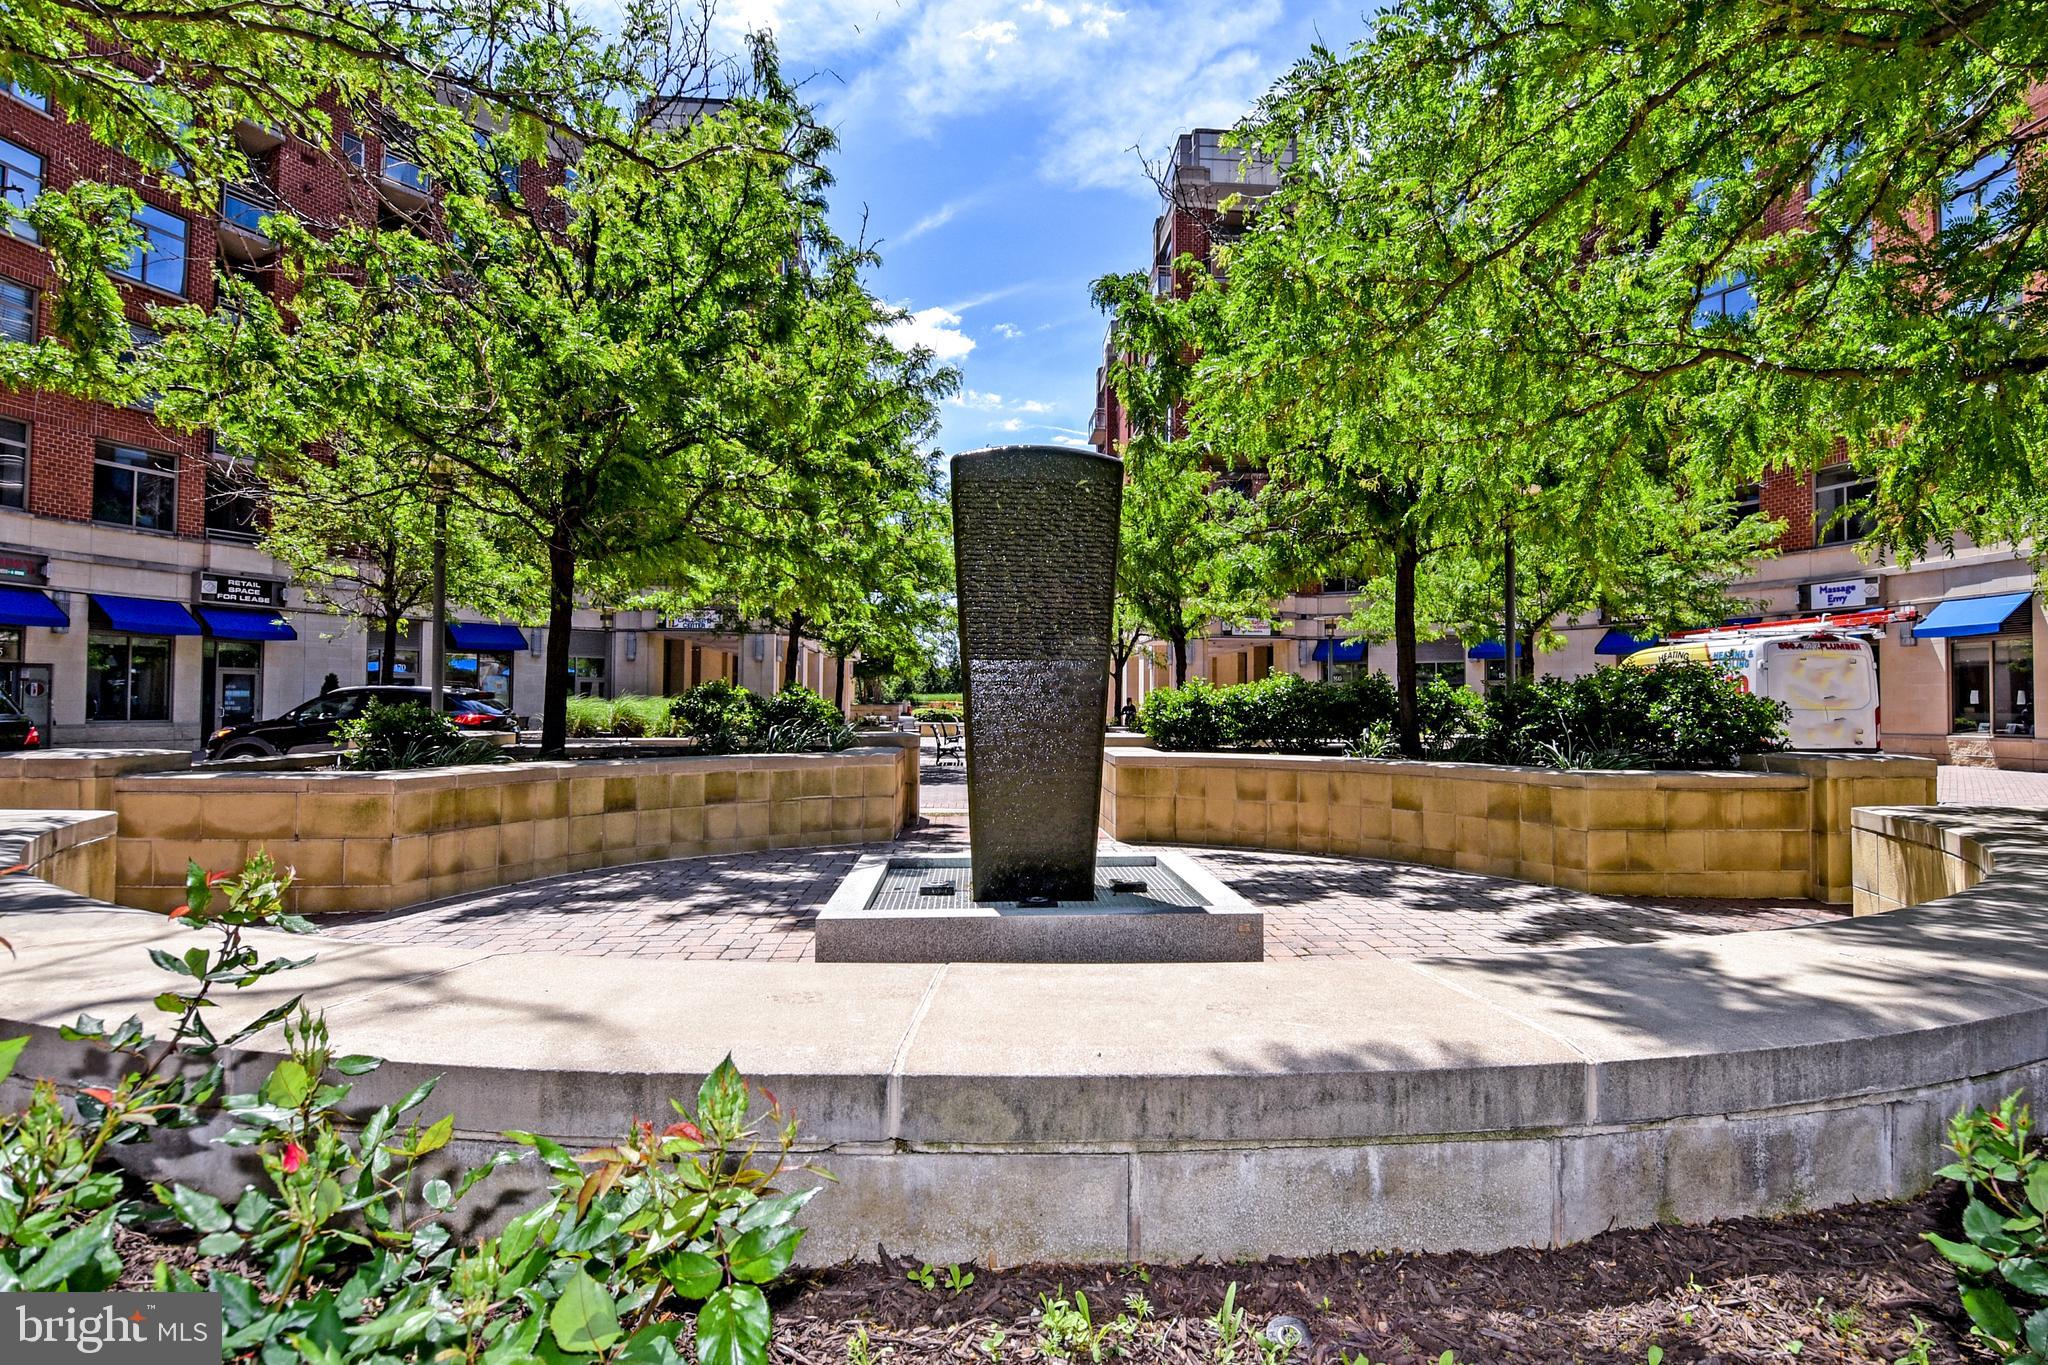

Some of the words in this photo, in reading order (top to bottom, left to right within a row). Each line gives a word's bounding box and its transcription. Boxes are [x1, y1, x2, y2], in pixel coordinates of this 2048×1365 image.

[228, 579, 261, 588] RETAIL
[228, 587, 261, 596] SPACE
[1819, 585, 1856, 594] Massage
[217, 593, 237, 601] FOR
[239, 595, 271, 604] LEASE
[1828, 594, 1848, 605] Envy
[1658, 651, 1689, 663] HEATING
[1713, 650, 1746, 660] HEAING
